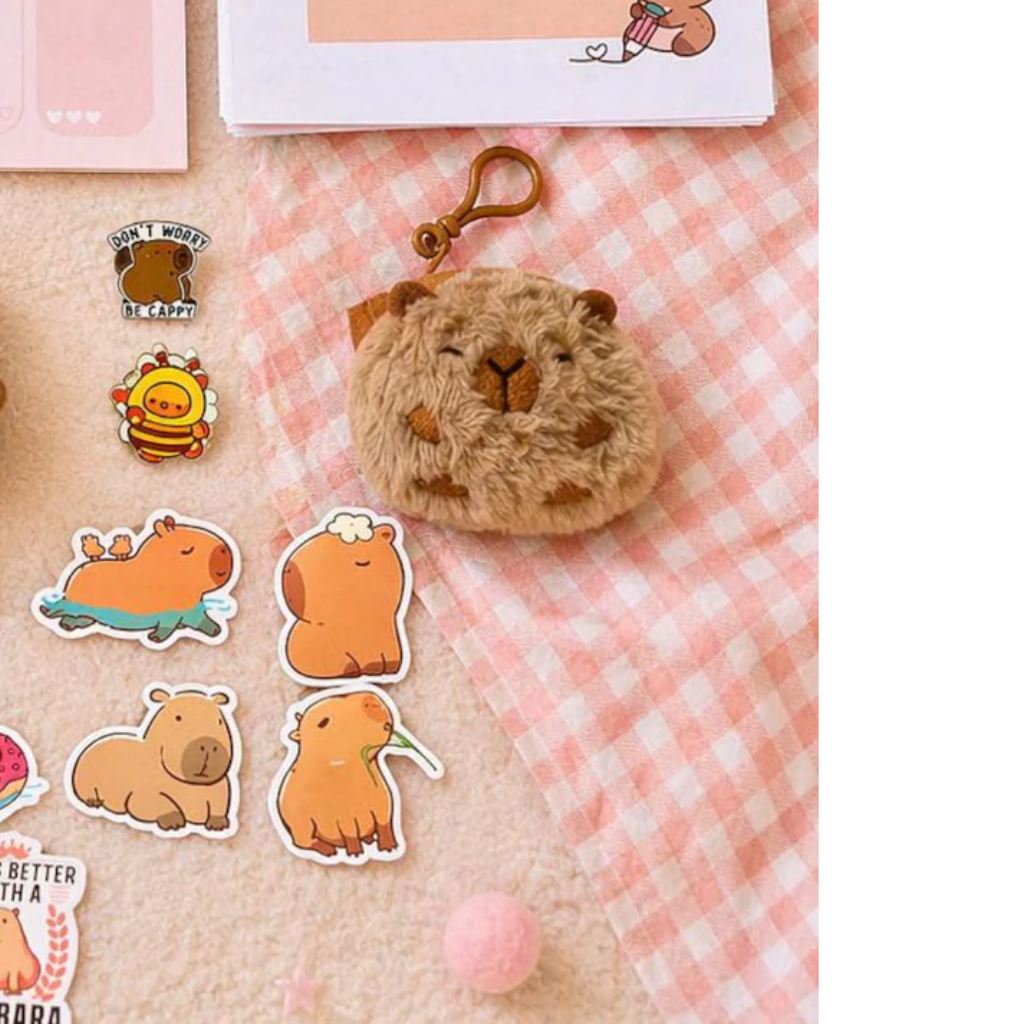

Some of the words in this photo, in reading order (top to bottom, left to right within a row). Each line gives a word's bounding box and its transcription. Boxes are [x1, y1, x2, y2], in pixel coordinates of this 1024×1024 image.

[111, 224, 154, 248] DON'T
[161, 224, 208, 248] WORRY
[125, 304, 141, 317] BE
[148, 304, 193, 317] CAPPY
[8, 862, 77, 885] BETTER
[29, 884, 42, 904] A
